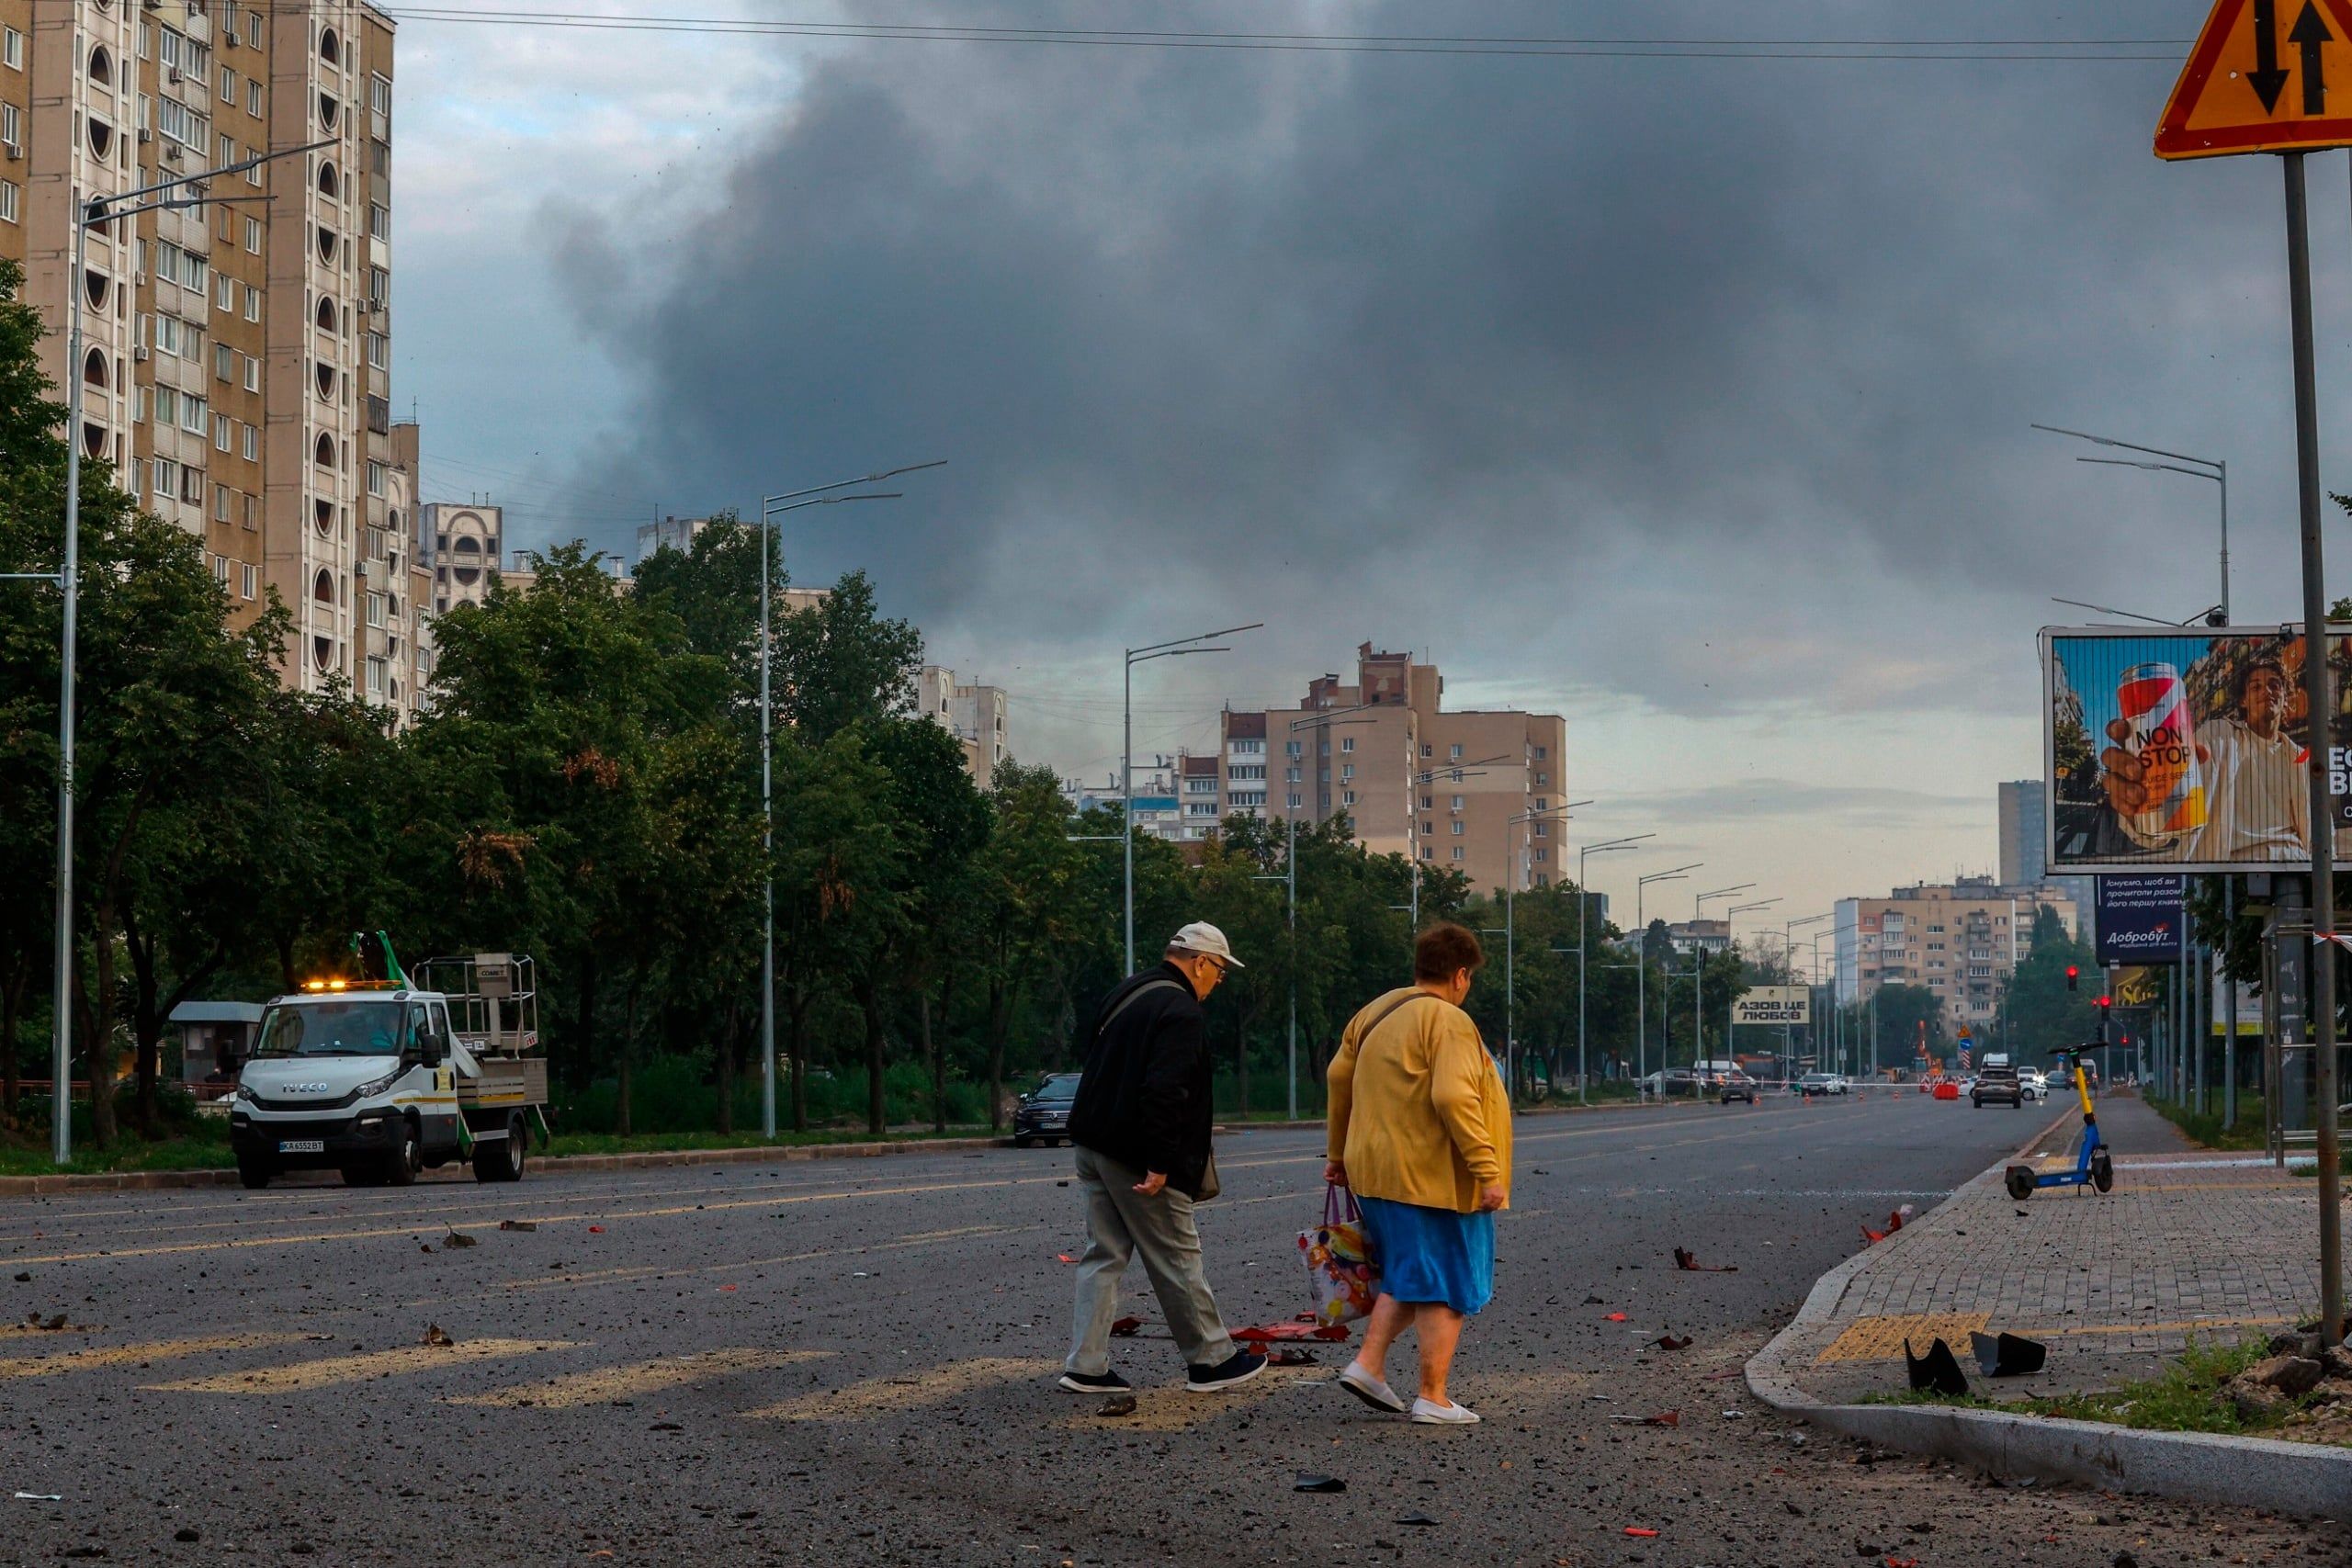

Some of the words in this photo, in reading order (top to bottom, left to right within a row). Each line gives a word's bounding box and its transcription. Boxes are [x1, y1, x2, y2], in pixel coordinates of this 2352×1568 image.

[2136, 727, 2184, 749] NON
[2139, 745, 2191, 769] STOP
[2106, 879, 2143, 888] Існуємо,
[2144, 877, 2164, 886] щоб
[2106, 889, 2152, 898] прочитали
[2154, 888, 2181, 897] разом
[2107, 899, 2127, 908] його
[2128, 899, 2156, 908] першу
[2107, 931, 2169, 944] Добробут
[1738, 1002, 1781, 1010] АЗОВ
[1784, 1002, 1806, 1010] ЦЕ
[1743, 1011, 1802, 1020] ЛЮБОВ
[283, 1082, 328, 1093] IVECO
